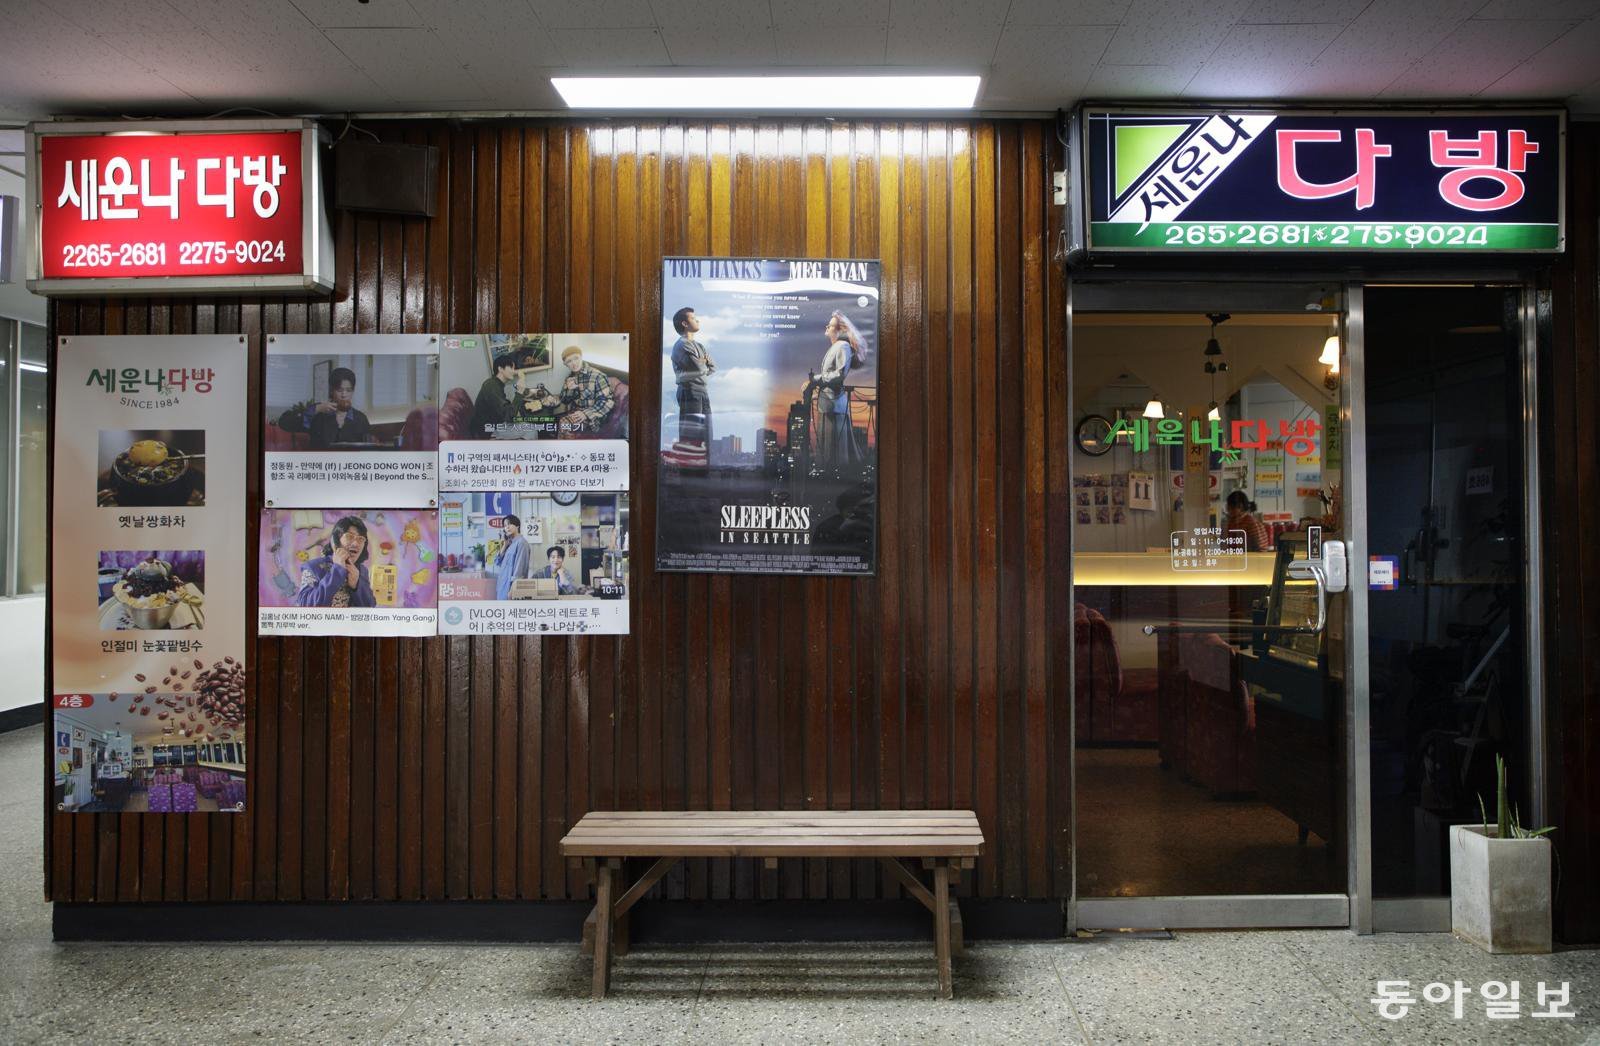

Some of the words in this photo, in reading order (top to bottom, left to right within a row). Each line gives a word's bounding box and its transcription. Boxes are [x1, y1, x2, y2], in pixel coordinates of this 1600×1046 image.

[1134, 113, 1255, 236] 세운나
[196, 154, 287, 219] 다방
[62, 243, 167, 267] 2265-2681
[179, 240, 286, 265] 2275-9024
[669, 259, 701, 278] TOM
[709, 260, 762, 279] HANKS
[789, 262, 823, 281] MEG
[829, 262, 868, 282] RYAN
[85, 367, 215, 393] 세운나다방
[119, 396, 153, 410] SINCE
[155, 396, 180, 409] 1984
[511, 422, 558, 433] 사진부터
[1103, 418, 1324, 457] 세운나다방
[457, 453, 465, 462] 이
[467, 453, 491, 462] 구역의
[589, 452, 606, 462] 동묘
[270, 462, 294, 471] 정동원
[300, 462, 323, 471] 만약에
[324, 462, 337, 471] (If)
[343, 462, 372, 470] JEONG
[373, 462, 399, 470] DONG
[400, 462, 421, 470] WON
[426, 462, 434, 470] 조
[444, 464, 469, 474] 수하러
[470, 464, 512, 474] 왔습니다!!!
[530, 465, 546, 473] 127
[547, 465, 568, 473] VIBE
[570, 465, 590, 473] EP.4
[296, 472, 326, 481] 리메이크
[331, 472, 369, 481] 야외녹음실
[374, 473, 405, 482] Beyond
[444, 479, 469, 488] 조회수
[470, 479, 498, 488] 25만회
[502, 479, 516, 488] 8일
[518, 479, 527, 488] 전
[529, 479, 577, 488] #TAEYONG
[580, 478, 605, 488] 더보기
[118, 515, 186, 529] 옛날쌍화차
[720, 505, 810, 530] SLEEPLESS
[526, 525, 539, 536] 22
[1193, 527, 1222, 536] 영업시간
[720, 531, 735, 543] IN
[743, 532, 810, 545] SEATTLE
[601, 586, 623, 594] 10:11
[281, 613, 298, 621] (KIM
[300, 613, 323, 621] HONG
[324, 613, 345, 621] NAM)
[391, 614, 411, 623] Yang
[412, 614, 436, 623] Gang)
[469, 608, 505, 620] [VLOG]
[508, 608, 556, 619] 세븐어스의
[558, 607, 589, 619] 레트로
[591, 607, 601, 618] 투
[469, 621, 479, 632] 어
[486, 621, 515, 632] 추억의
[517, 621, 537, 632] 다방
[101, 639, 138, 653] 인절미
[142, 639, 203, 653] 눈꽃팥빙수
[59, 694, 84, 708] 4층
